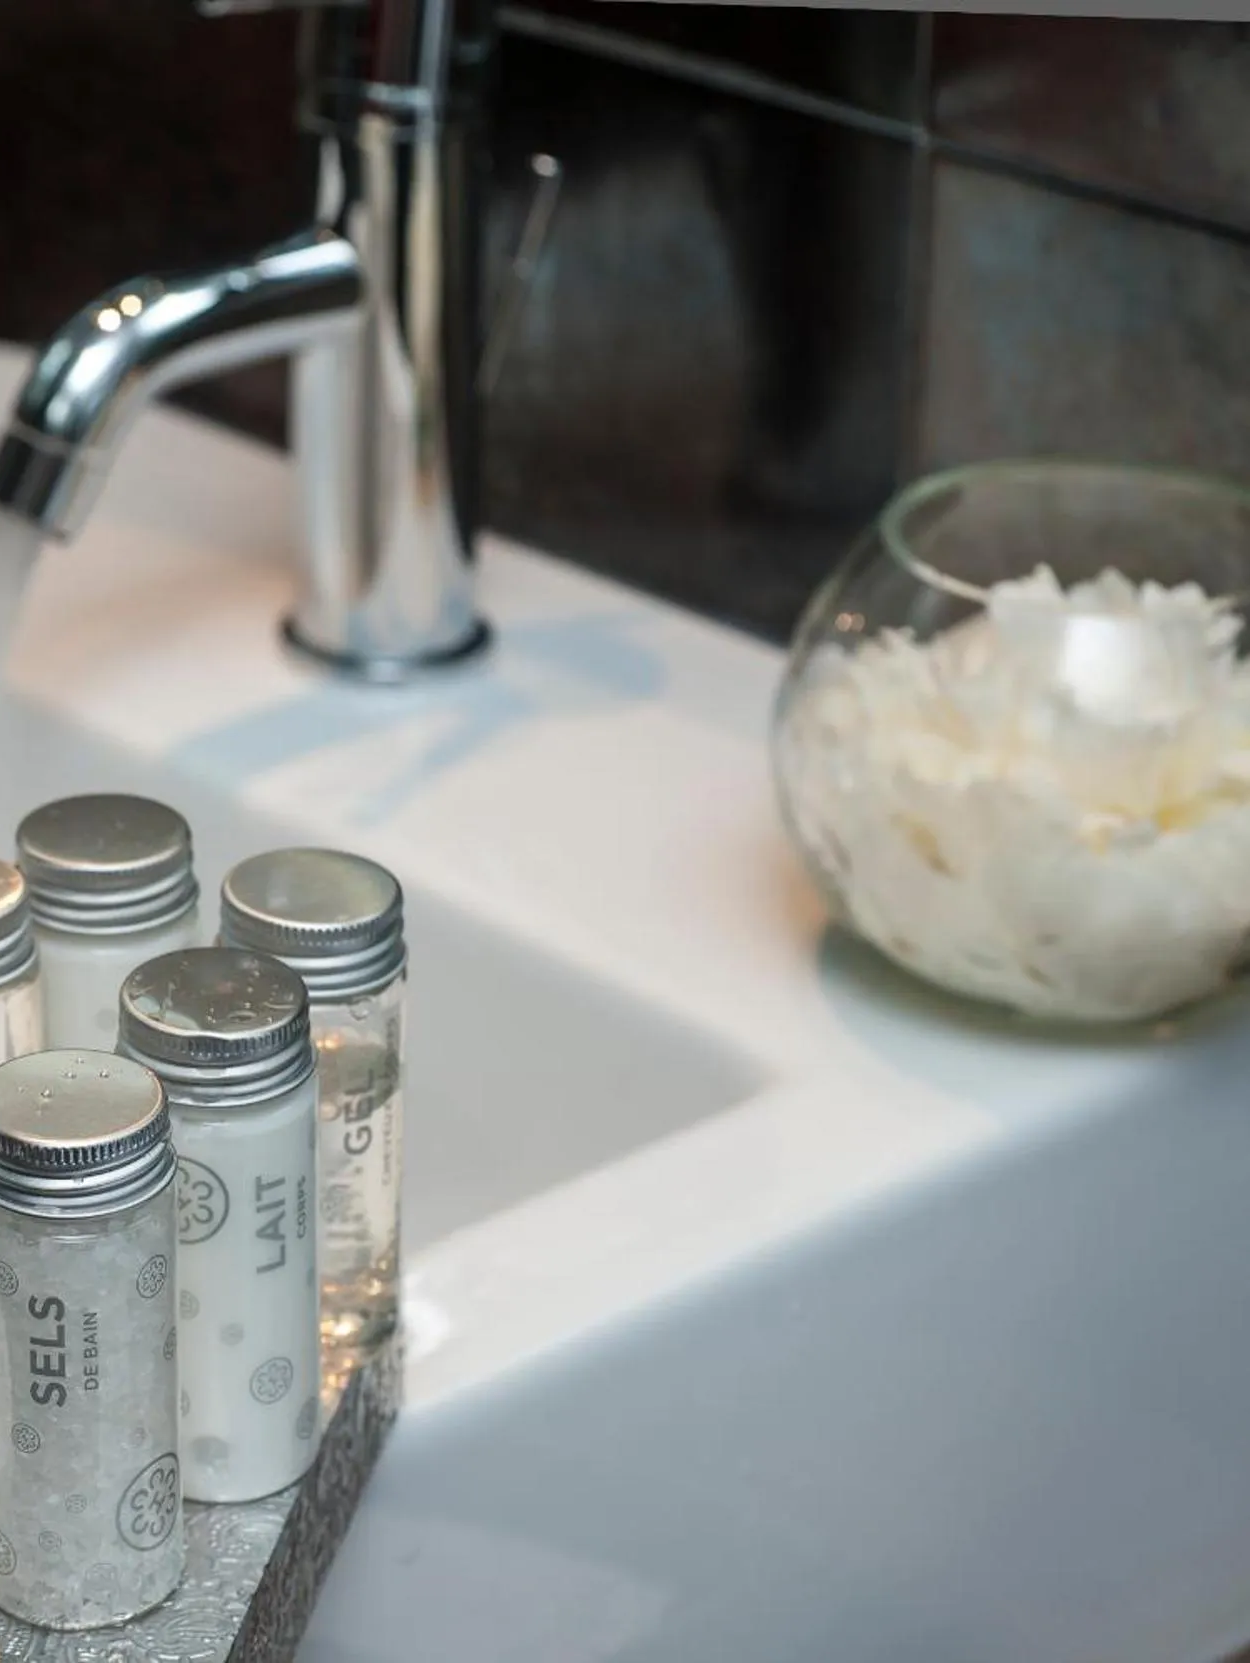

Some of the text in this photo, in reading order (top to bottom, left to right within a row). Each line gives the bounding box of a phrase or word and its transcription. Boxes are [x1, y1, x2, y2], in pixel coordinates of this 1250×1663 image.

[344, 1068, 374, 1155] GEL
[255, 1175, 286, 1274] LAIT
[28, 1294, 68, 1408] SELS
[82, 1311, 100, 1392] DE BAIN
